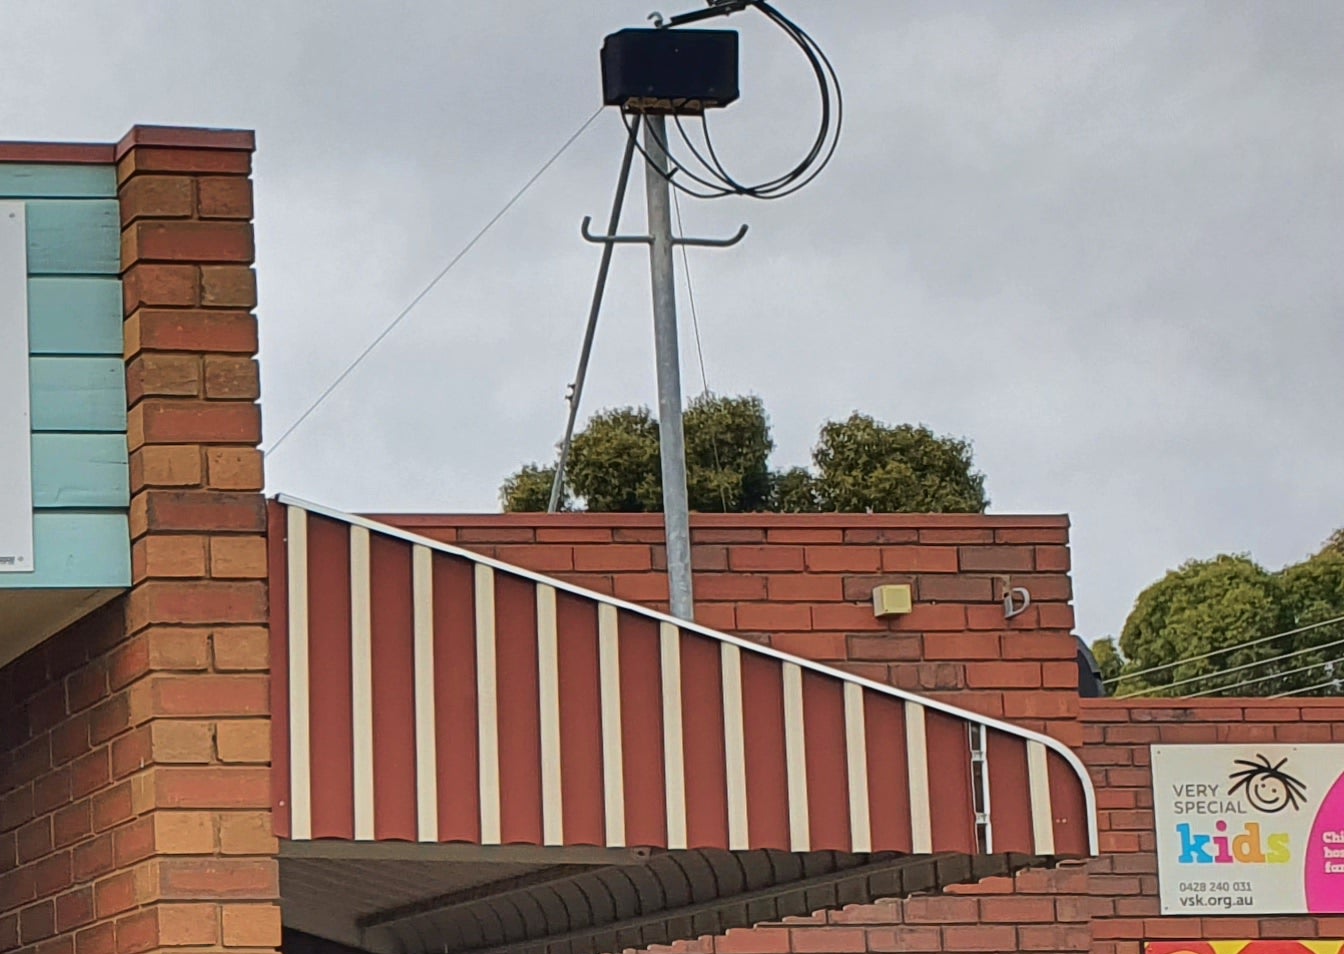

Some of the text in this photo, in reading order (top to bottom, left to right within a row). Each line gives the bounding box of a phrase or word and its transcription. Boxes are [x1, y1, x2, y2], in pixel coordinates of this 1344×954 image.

[1173, 784, 1219, 798] VERY
[1174, 801, 1247, 815] SPECIAL
[1176, 820, 1291, 864] kids
[1179, 882, 1252, 892] 0428 240 031
[1180, 894, 1253, 909] vsk.org.au
